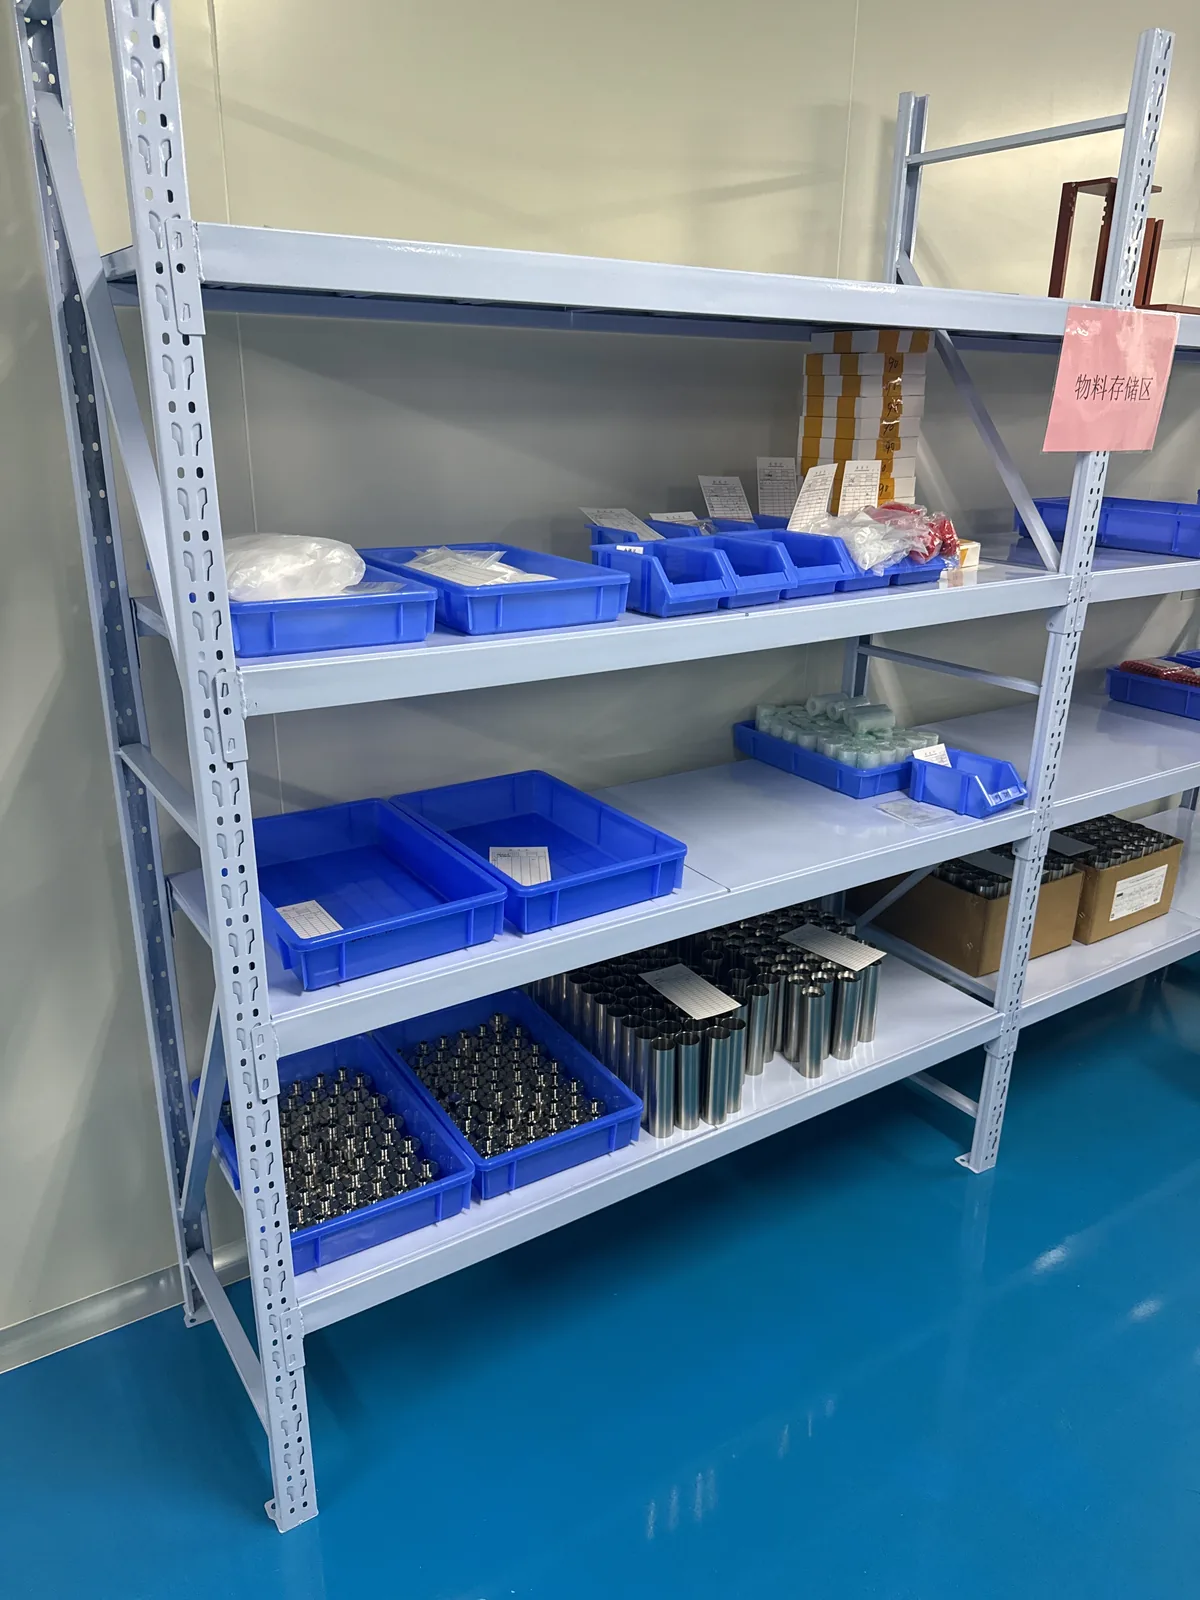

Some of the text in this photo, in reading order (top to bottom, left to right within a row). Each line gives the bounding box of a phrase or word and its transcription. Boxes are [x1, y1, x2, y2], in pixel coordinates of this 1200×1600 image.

[1074, 373, 1154, 402] 物料存储区
